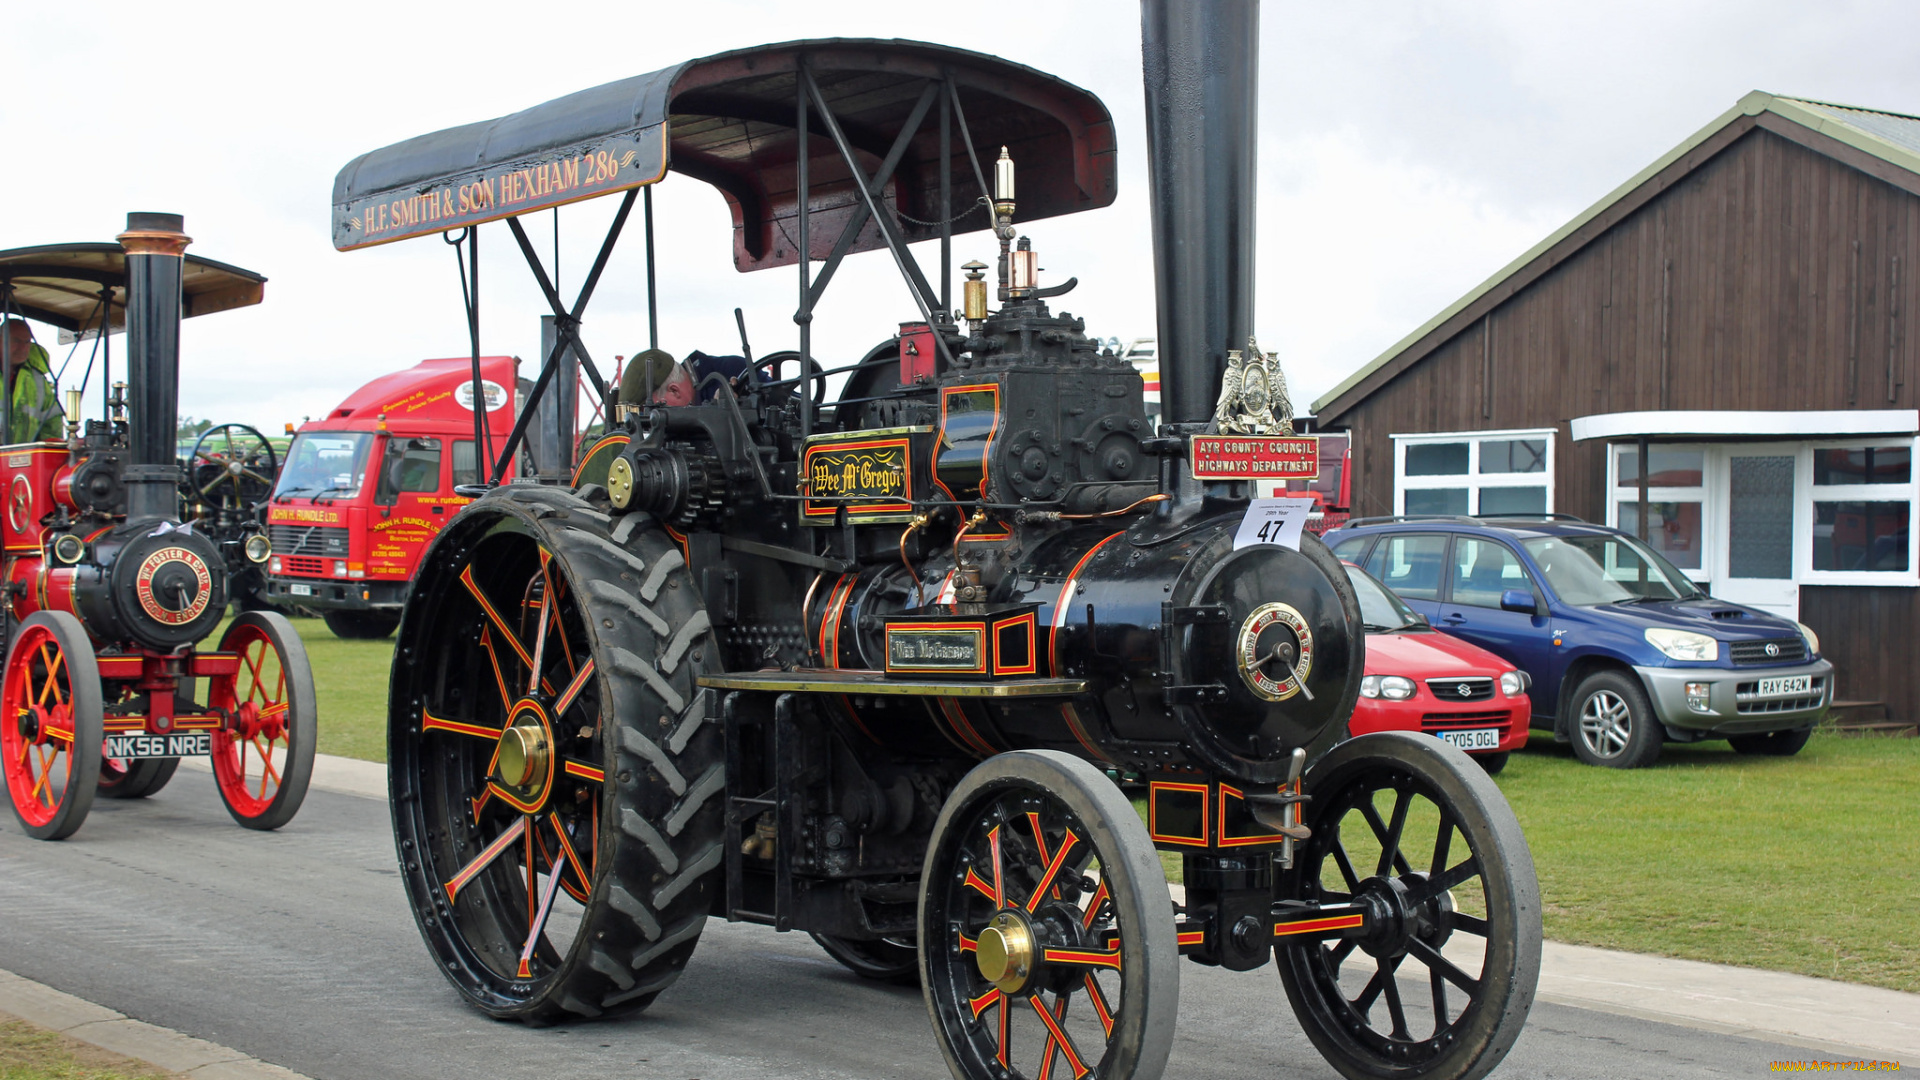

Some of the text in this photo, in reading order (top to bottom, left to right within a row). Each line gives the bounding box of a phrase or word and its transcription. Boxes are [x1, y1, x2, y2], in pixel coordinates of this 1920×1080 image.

[389, 190, 440, 228] SMITH
[442, 188, 455, 217] &
[458, 177, 495, 213] SON
[501, 157, 579, 204] HEXHAM
[585, 147, 619, 184] 286
[1200, 442, 1220, 454] AYR
[1224, 442, 1265, 454] COUNTY
[1198, 460, 1314, 472] HIGHWAYS DEPARTMENT
[814, 464, 840, 492] Wee
[271, 508, 289, 520] JOHN
[296, 510, 325, 522] RUNDLE
[373, 520, 393, 533] JOHN
[402, 517, 432, 529] RUNDLE
[1257, 520, 1285, 543] 47
[148, 549, 184, 569] FOSTER
[185, 553, 193, 562] &
[1762, 678, 1808, 695] RAY 642W
[109, 736, 210, 756] NK56 NRE
[1476, 731, 1498, 746] OGL
